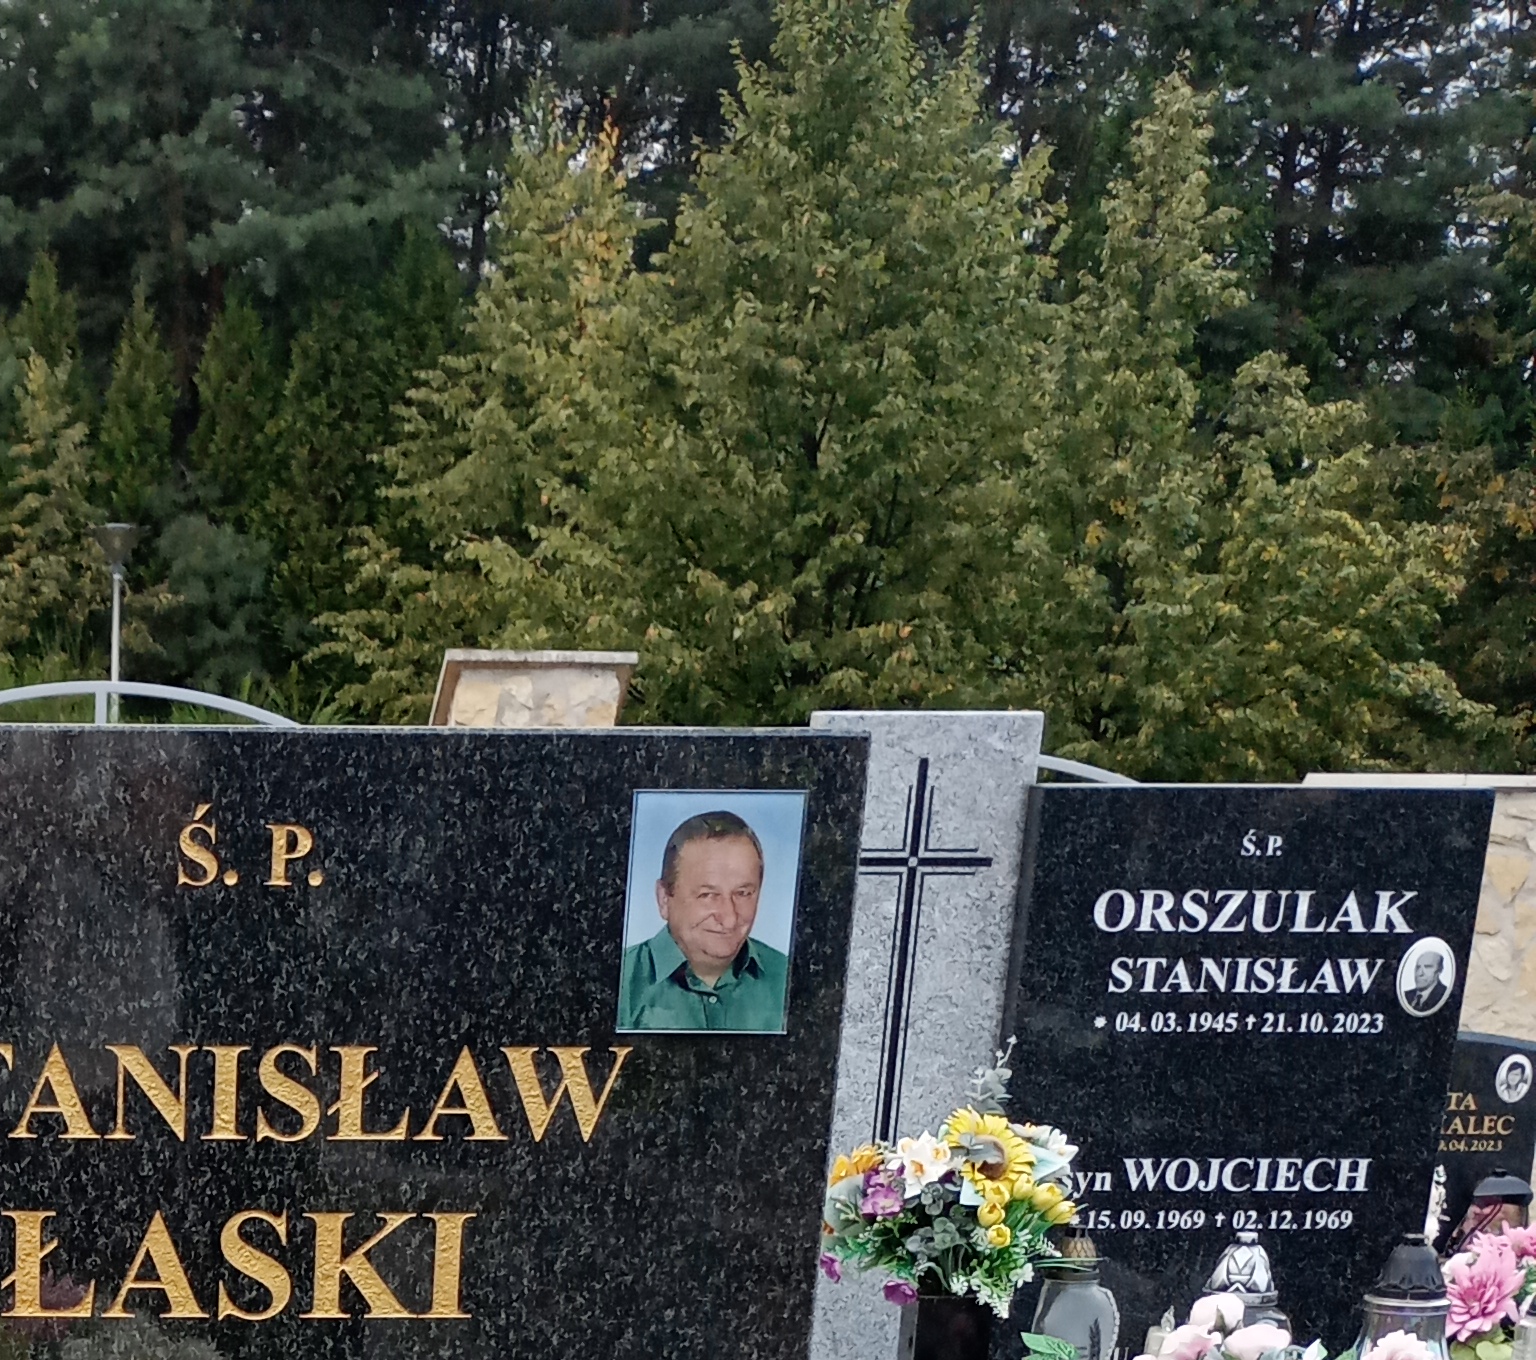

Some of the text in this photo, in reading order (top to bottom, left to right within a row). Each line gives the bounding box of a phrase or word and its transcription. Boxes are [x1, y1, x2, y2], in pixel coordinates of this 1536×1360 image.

[177, 803, 324, 887] Ś. P.
[1093, 888, 1419, 933] ORSZULAK
[1107, 957, 1385, 994] STANISŁAW
[1445, 1091, 1478, 1112] TA
[1060, 1157, 1373, 1199] syn WOJCIECH
[0, 1209, 476, 1321] ŁASKI
